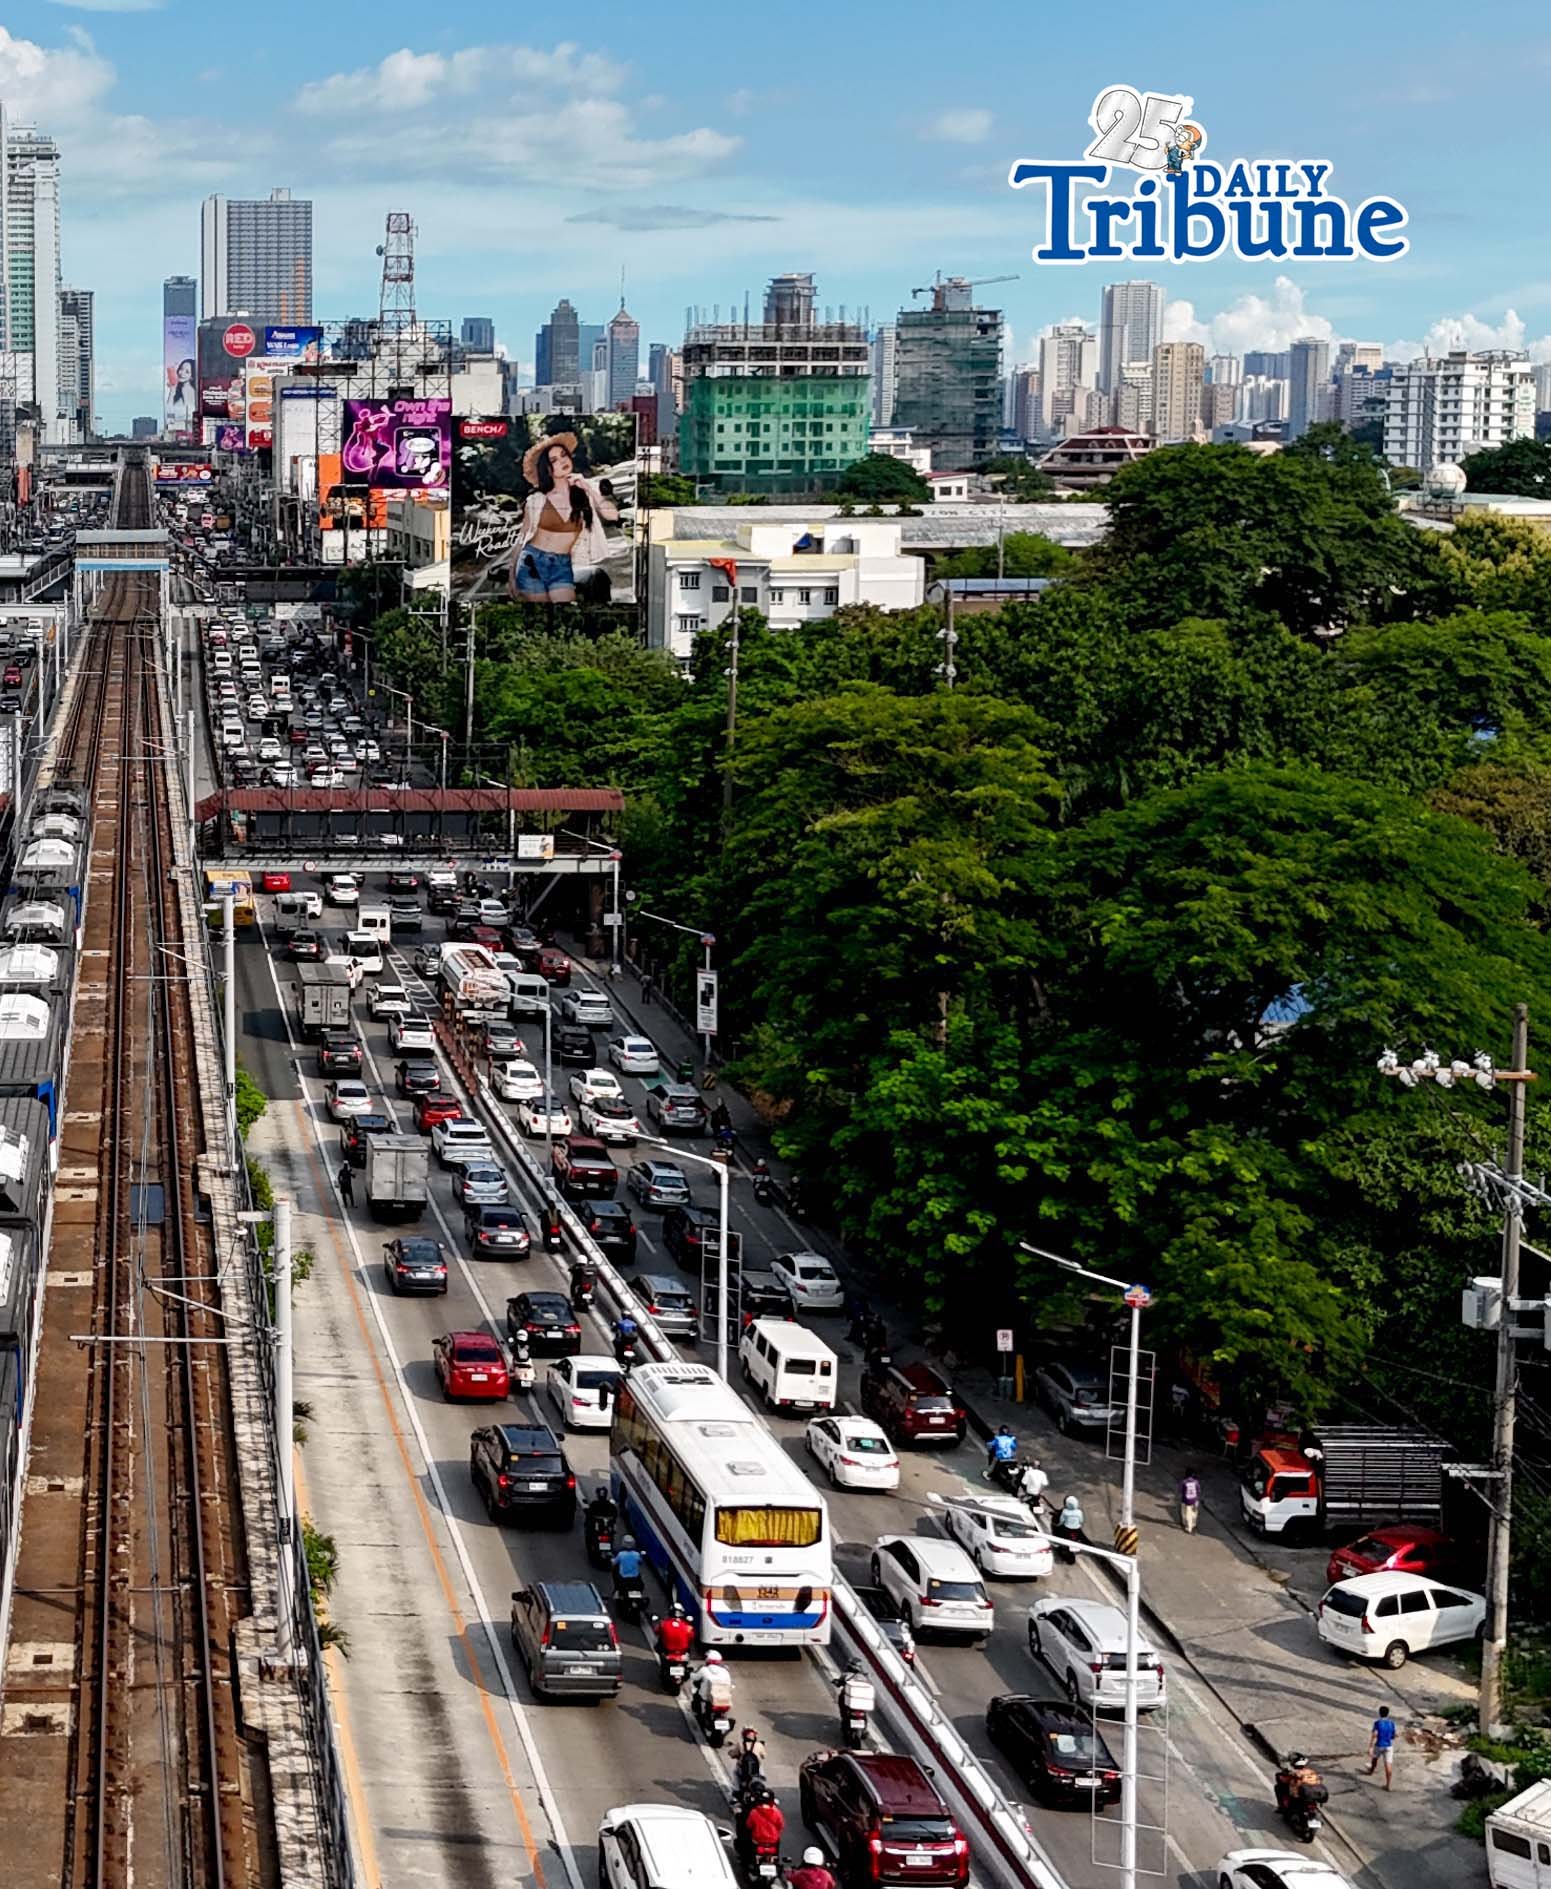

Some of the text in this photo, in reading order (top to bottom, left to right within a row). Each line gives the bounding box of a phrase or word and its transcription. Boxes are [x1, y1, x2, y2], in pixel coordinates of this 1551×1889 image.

[394, 401, 426, 412] Own
[402, 412, 438, 425] night
[459, 519, 510, 545] Weekend
